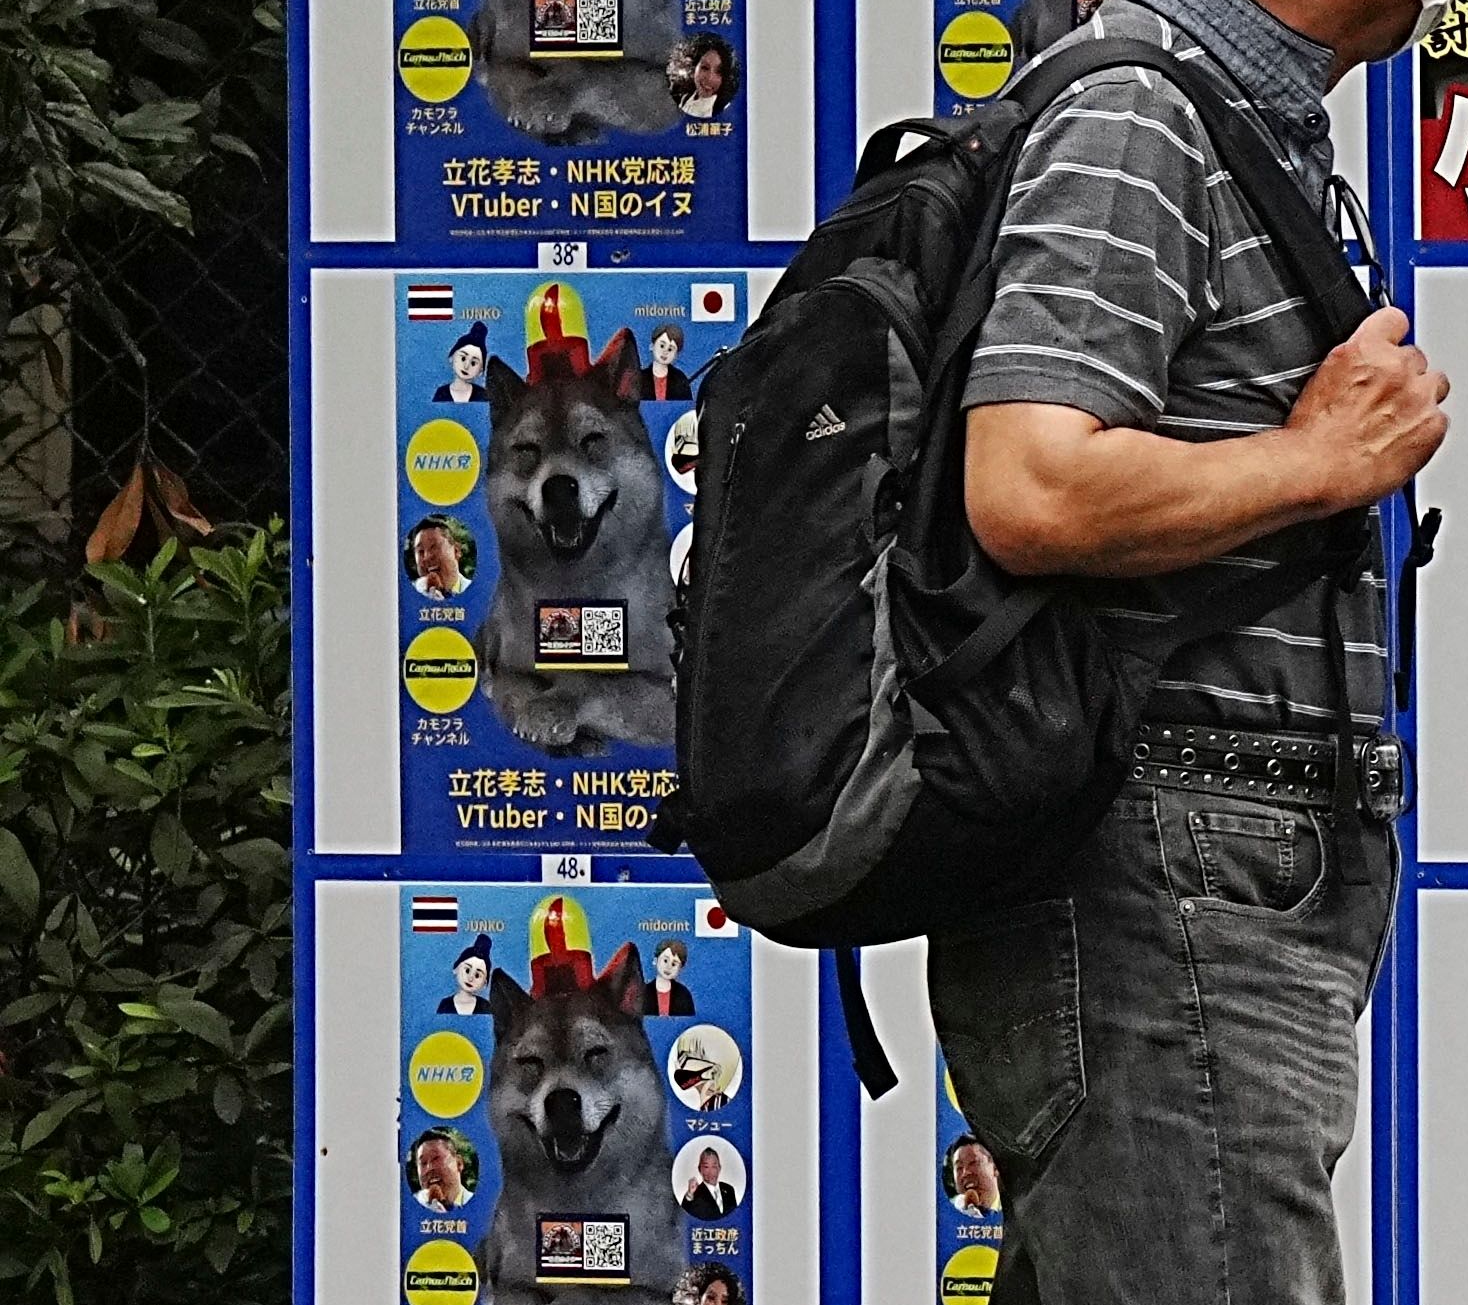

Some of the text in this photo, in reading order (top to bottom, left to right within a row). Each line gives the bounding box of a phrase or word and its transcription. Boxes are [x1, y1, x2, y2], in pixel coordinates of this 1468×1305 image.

[443, 150, 696, 193] 立花孝志・NHK党応援
[806, 422, 845, 440] adidas
